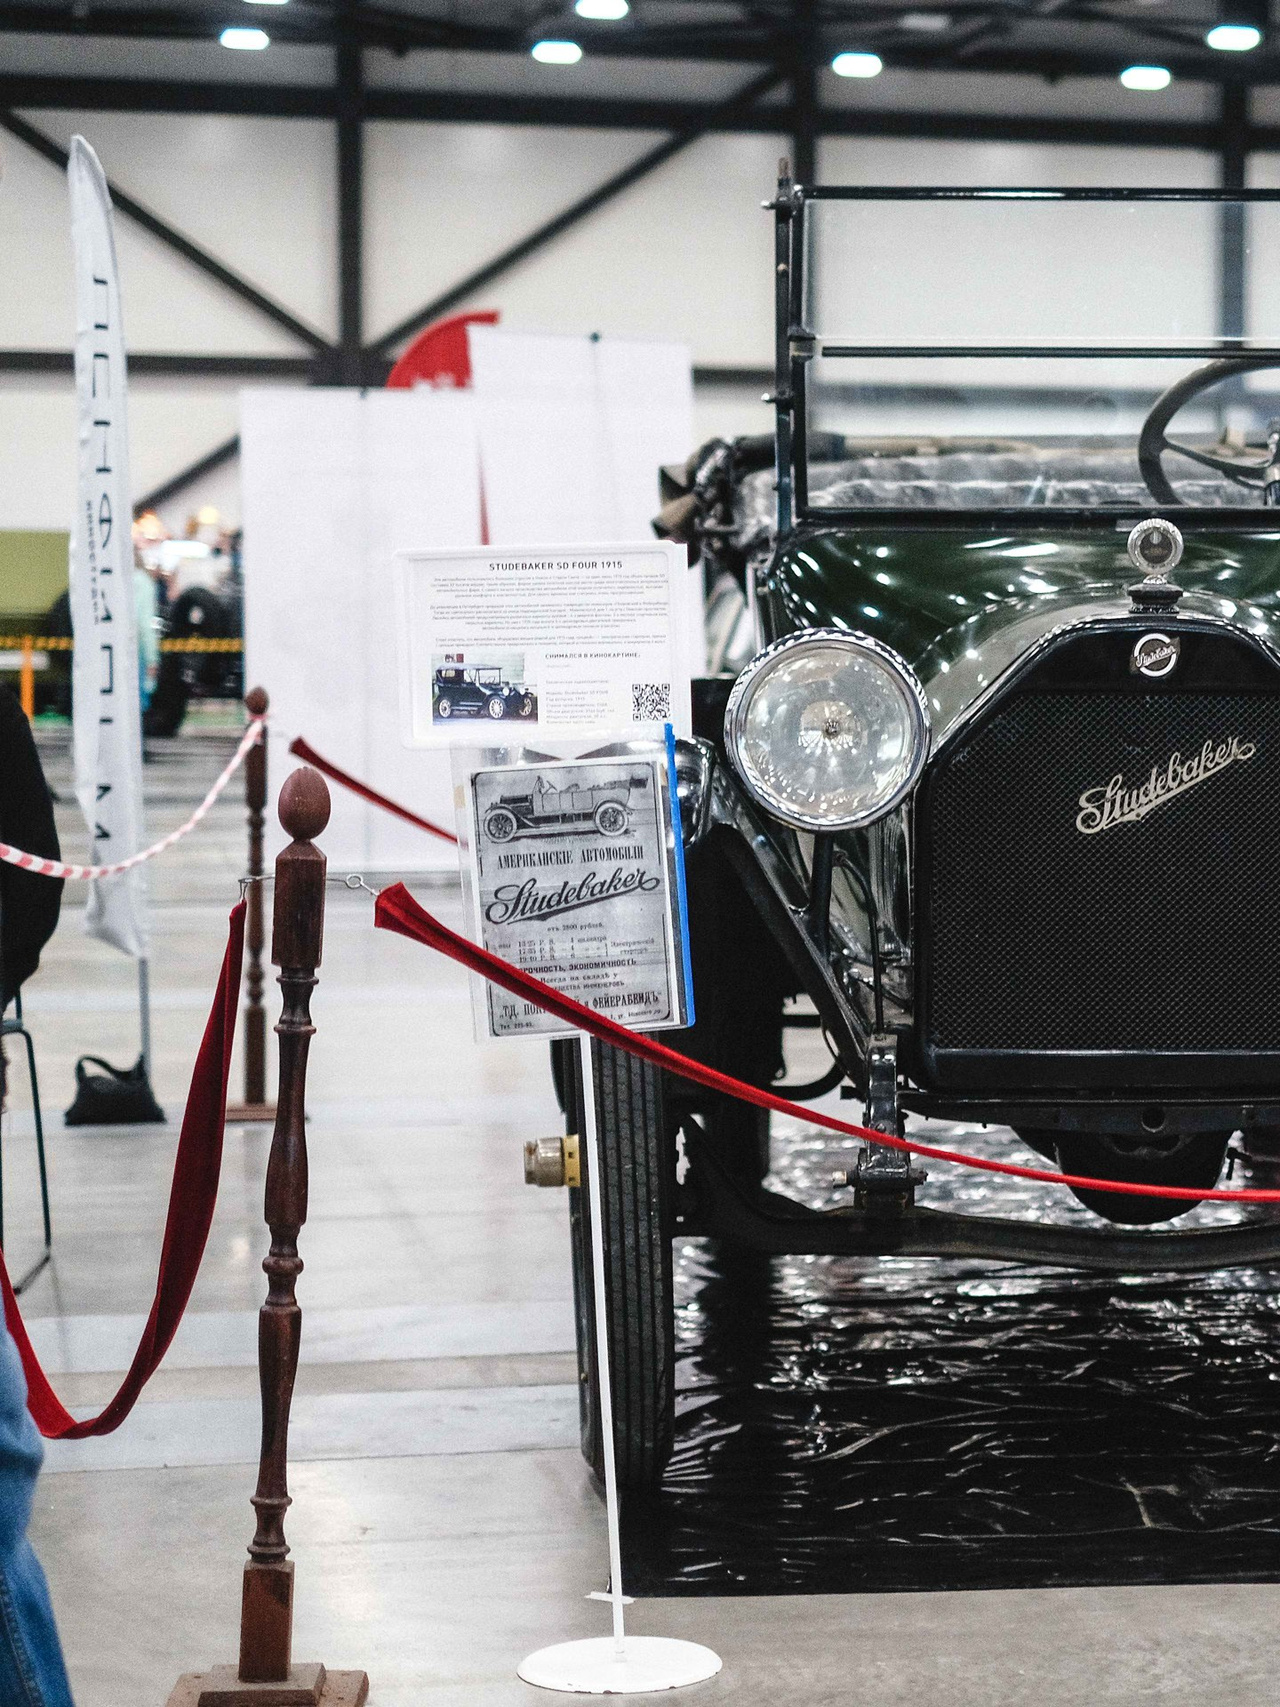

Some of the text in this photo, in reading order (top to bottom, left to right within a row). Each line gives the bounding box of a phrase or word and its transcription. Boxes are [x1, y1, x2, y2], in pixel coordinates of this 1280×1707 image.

[489, 561, 623, 571] STUDEBAKER SD FOUR 1915
[1135, 645, 1177, 668] Studebaker
[1076, 737, 1256, 834] Studebaker
[580, 846, 644, 864] АВТОМОБИЛИ
[485, 867, 660, 925] Studebaker
[520, 958, 637, 974] РОЧНОСТЬ, ЭКОНОМИЧНОСТЬ
